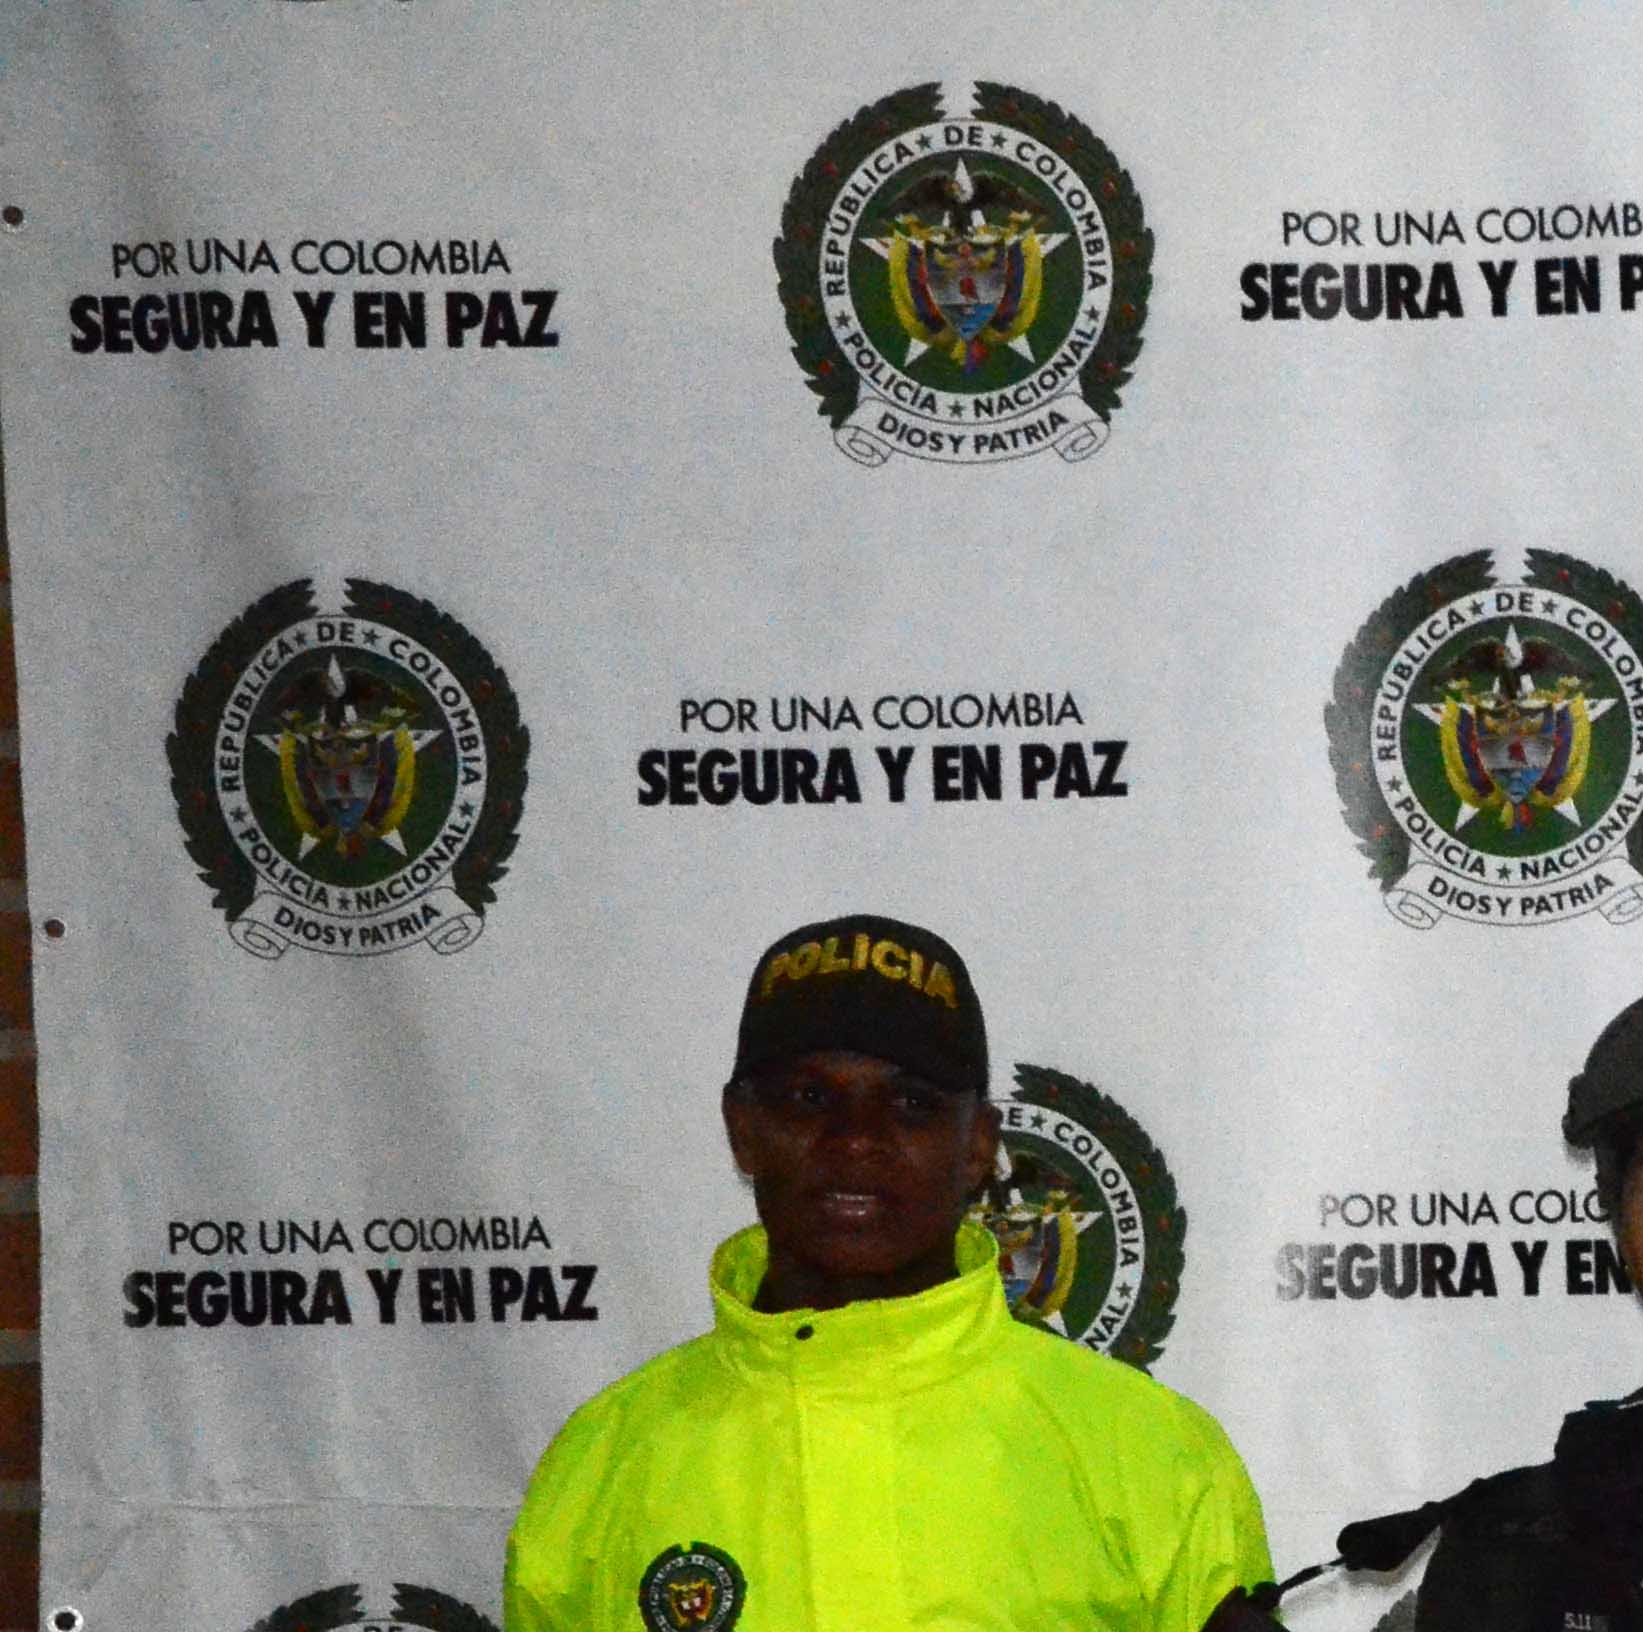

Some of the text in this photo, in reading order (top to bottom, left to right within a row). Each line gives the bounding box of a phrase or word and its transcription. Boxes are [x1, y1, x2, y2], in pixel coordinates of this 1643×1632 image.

[943, 125, 985, 147] DE
[1015, 141, 1107, 291] COLOMBIA
[1281, 210, 1362, 247] POR
[1374, 210, 1466, 248] UNA
[111, 237, 512, 280] POR UNA COLOMBIA
[1239, 260, 1465, 323] SEGURA
[1477, 258, 1518, 318] Y
[1533, 254, 1602, 317] EN
[67, 287, 560, 357] SEGURA Y EN PAZ
[973, 326, 1098, 420] NACIONAL
[974, 410, 1071, 454] PATRIA
[1494, 591, 1536, 614] DE
[679, 691, 1084, 734] POR UNA COLOMBIA
[636, 739, 1129, 807] SEGURA Y EN PAZ
[1520, 872, 1616, 917] PATRIA
[760, 932, 960, 1009] POLICIA
[1319, 1190, 1499, 1227] POR UNA
[167, 1216, 551, 1258] POR UNA COLOMBIA
[122, 1263, 599, 1329] SEGURA Y EN PAZ
[1277, 1242, 1498, 1300] SEGURA
[1511, 1241, 1548, 1296] Y
